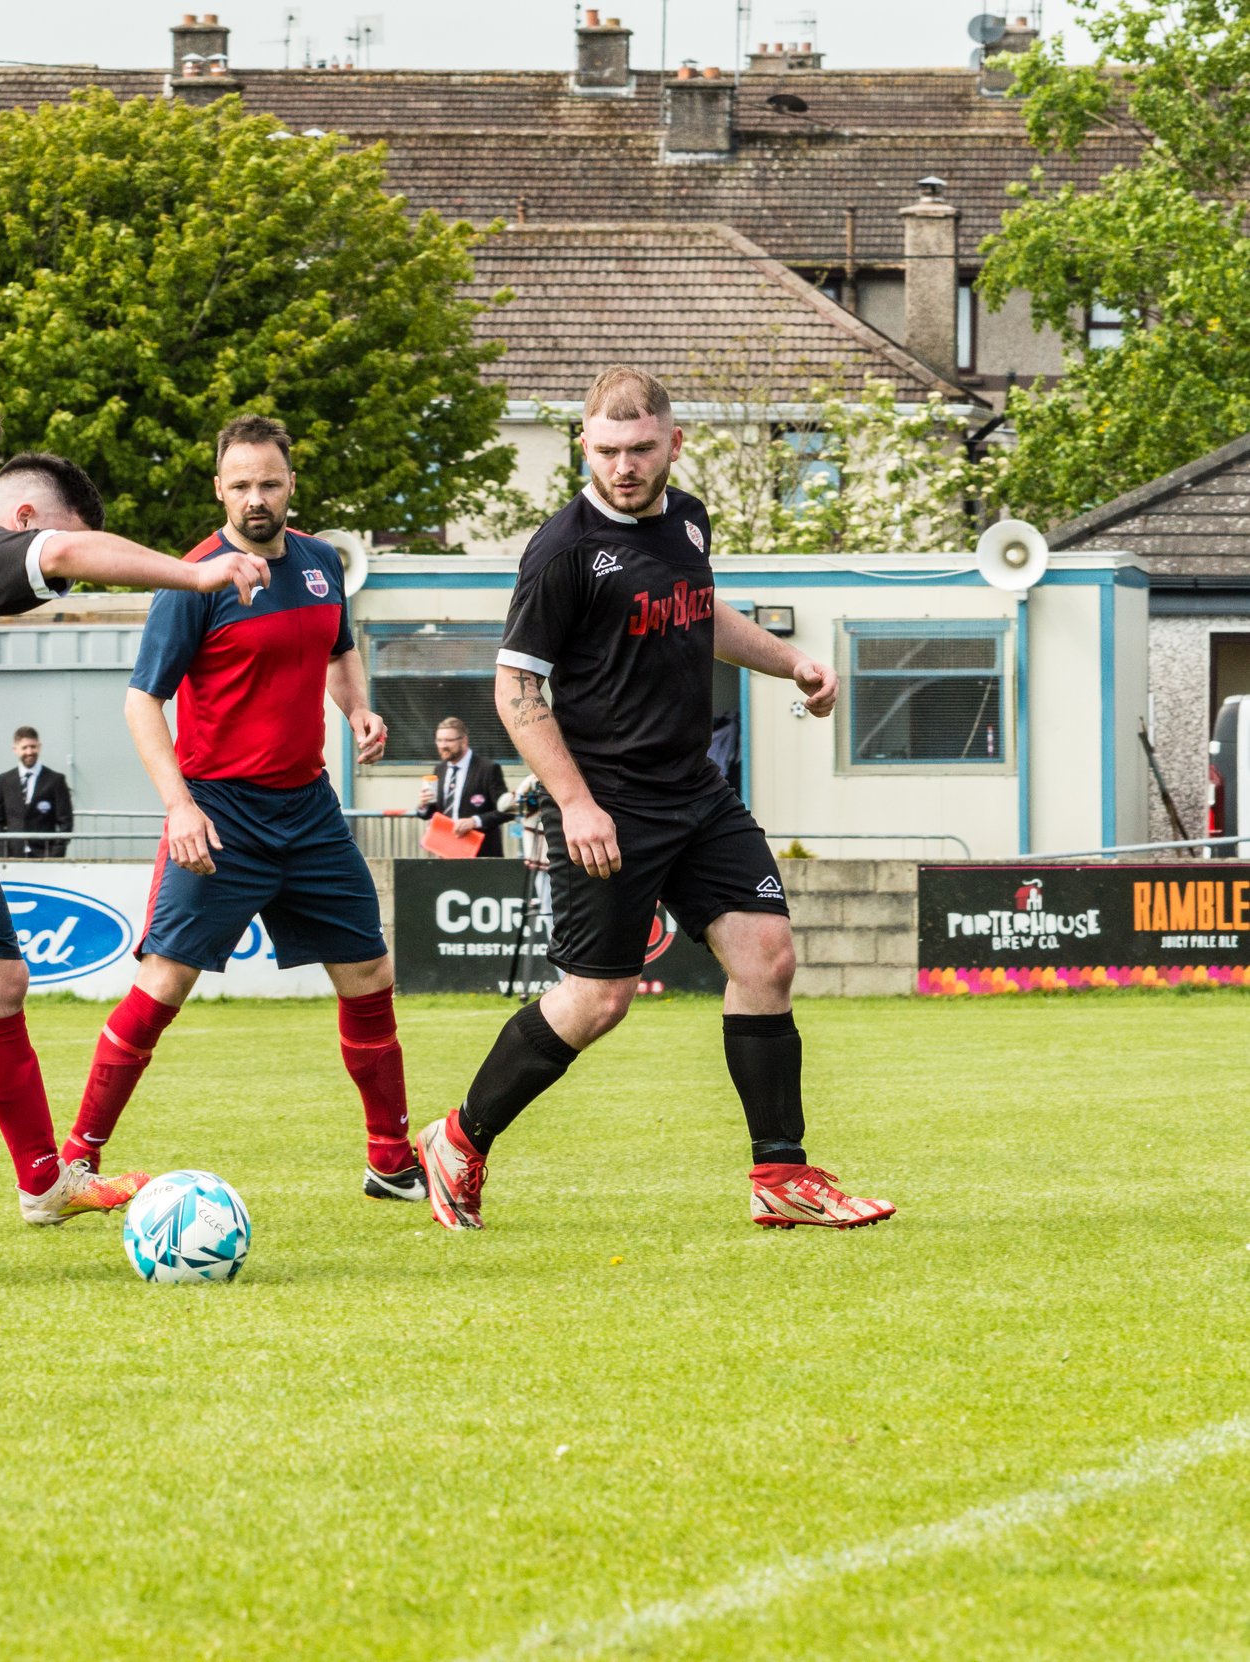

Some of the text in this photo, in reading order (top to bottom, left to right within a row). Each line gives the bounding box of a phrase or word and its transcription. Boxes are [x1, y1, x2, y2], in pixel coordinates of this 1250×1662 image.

[947, 909, 1101, 938] PORTERHOUSE
[992, 936, 1034, 950] BREW
[1161, 935, 1239, 948] JUICY PALE ALE
[438, 943, 465, 956] THE
[466, 943, 501, 956] BEST
